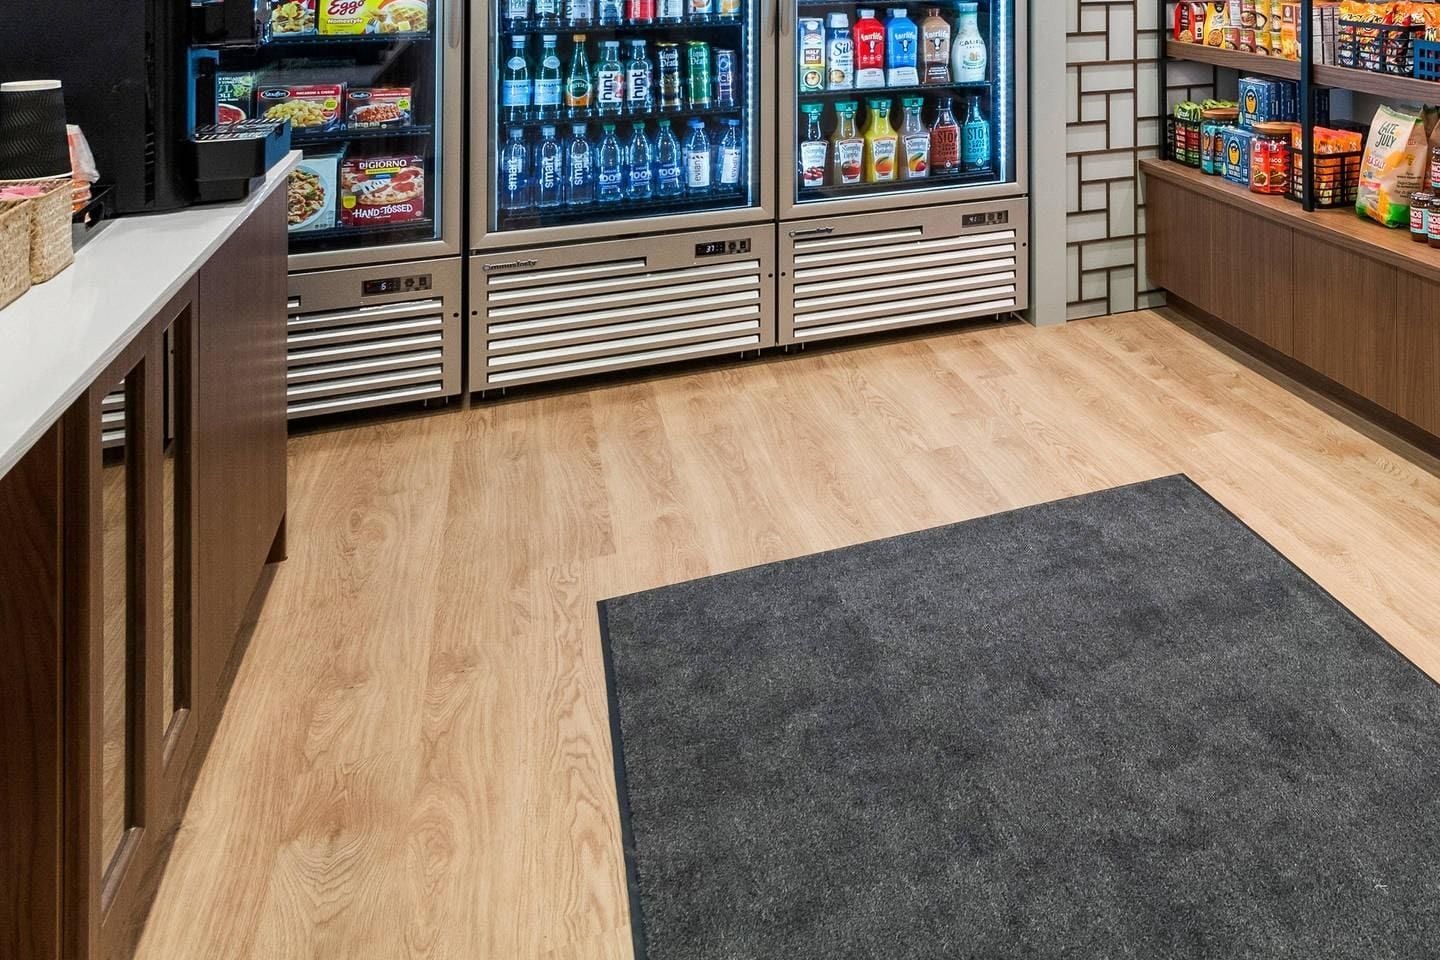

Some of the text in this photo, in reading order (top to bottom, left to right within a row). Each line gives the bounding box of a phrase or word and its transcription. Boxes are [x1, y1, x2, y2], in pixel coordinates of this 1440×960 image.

[327, 18, 364, 26] Homestyle
[601, 73, 614, 102] hint
[631, 70, 644, 100] hint
[1374, 135, 1397, 149] JULY
[1378, 121, 1400, 135] LATE
[507, 156, 518, 190] smart
[544, 156, 554, 189] smart
[574, 153, 585, 186] smart
[694, 157, 702, 185] evian
[352, 203, 414, 219] HAND-TOSSED
